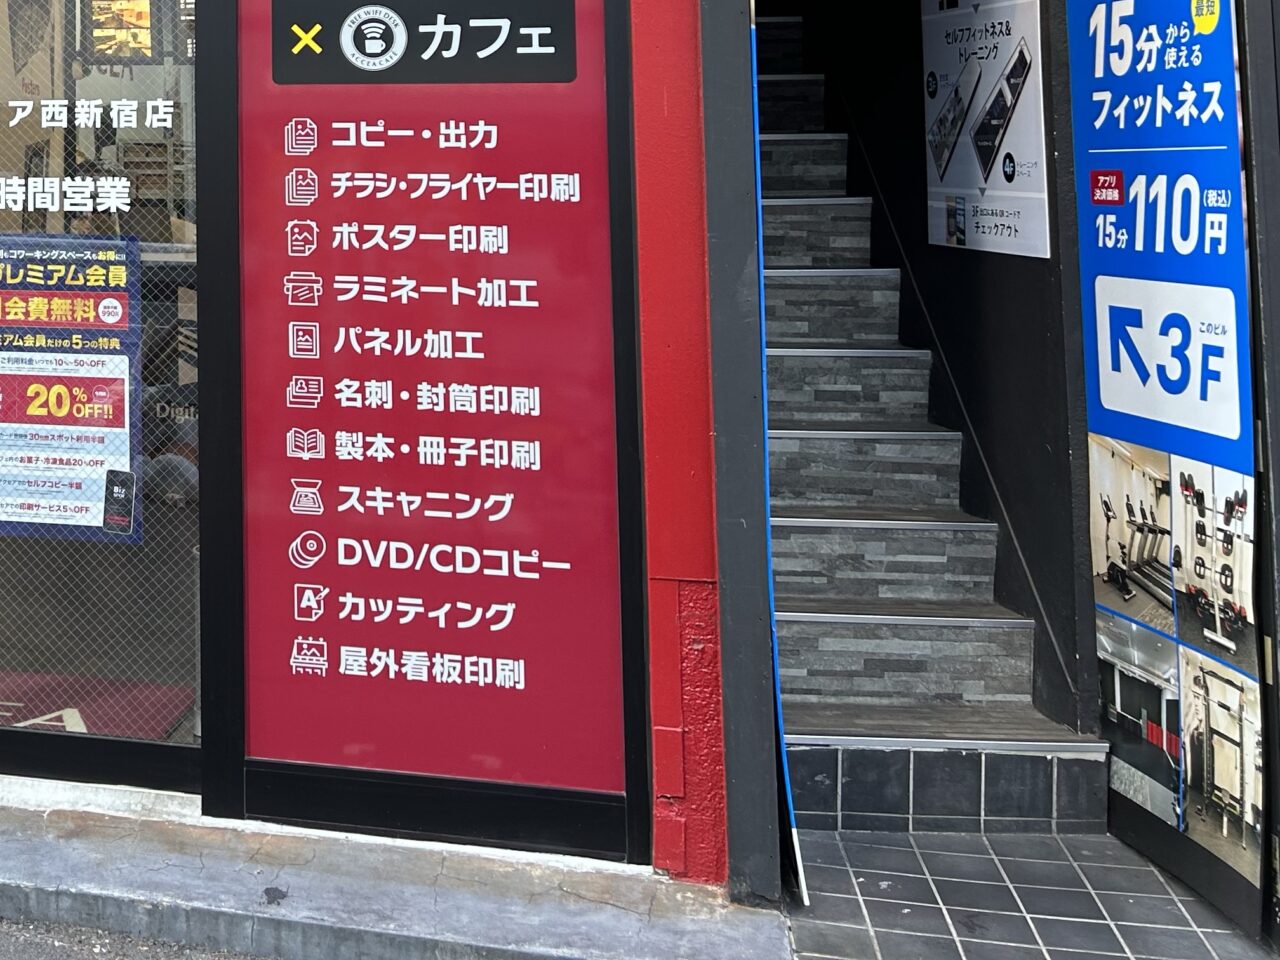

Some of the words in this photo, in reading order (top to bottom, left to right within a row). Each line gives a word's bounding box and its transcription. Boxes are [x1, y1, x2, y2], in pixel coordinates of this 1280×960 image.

[348, 13, 362, 28] FREE
[383, 12, 400, 29] DESK
[418, 14, 555, 60] カフェ
[1165, 21, 1190, 44] から
[959, 42, 999, 63] トレーニング
[1164, 44, 1202, 70] 使える
[1092, 80, 1225, 130] フィットネス
[331, 120, 497, 149] コピー・出力
[331, 172, 580, 202] チラシ・フライヤー印刷
[1097, 176, 1116, 187] アプリ
[1203, 189, 1232, 207] (税込)
[974, 221, 1019, 238] チェックアウト
[1095, 214, 1128, 249] 15分
[1128, 174, 1227, 255] 110円
[332, 221, 509, 254] ポスター印刷
[333, 275, 539, 307] ラミネート加工
[333, 326, 485, 359] パネル加工
[1199, 321, 1227, 336] このビル
[1156, 312, 1225, 402] 3F
[26, 383, 70, 417] 20
[334, 378, 540, 416] 名刺・封筒印刷
[334, 431, 541, 471] 製本・冊子印刷
[337, 485, 515, 522] スキャニング
[337, 537, 571, 580] DVD/CDコピー
[338, 592, 516, 631] カッティング
[339, 645, 525, 690] 屋外看板印刷
